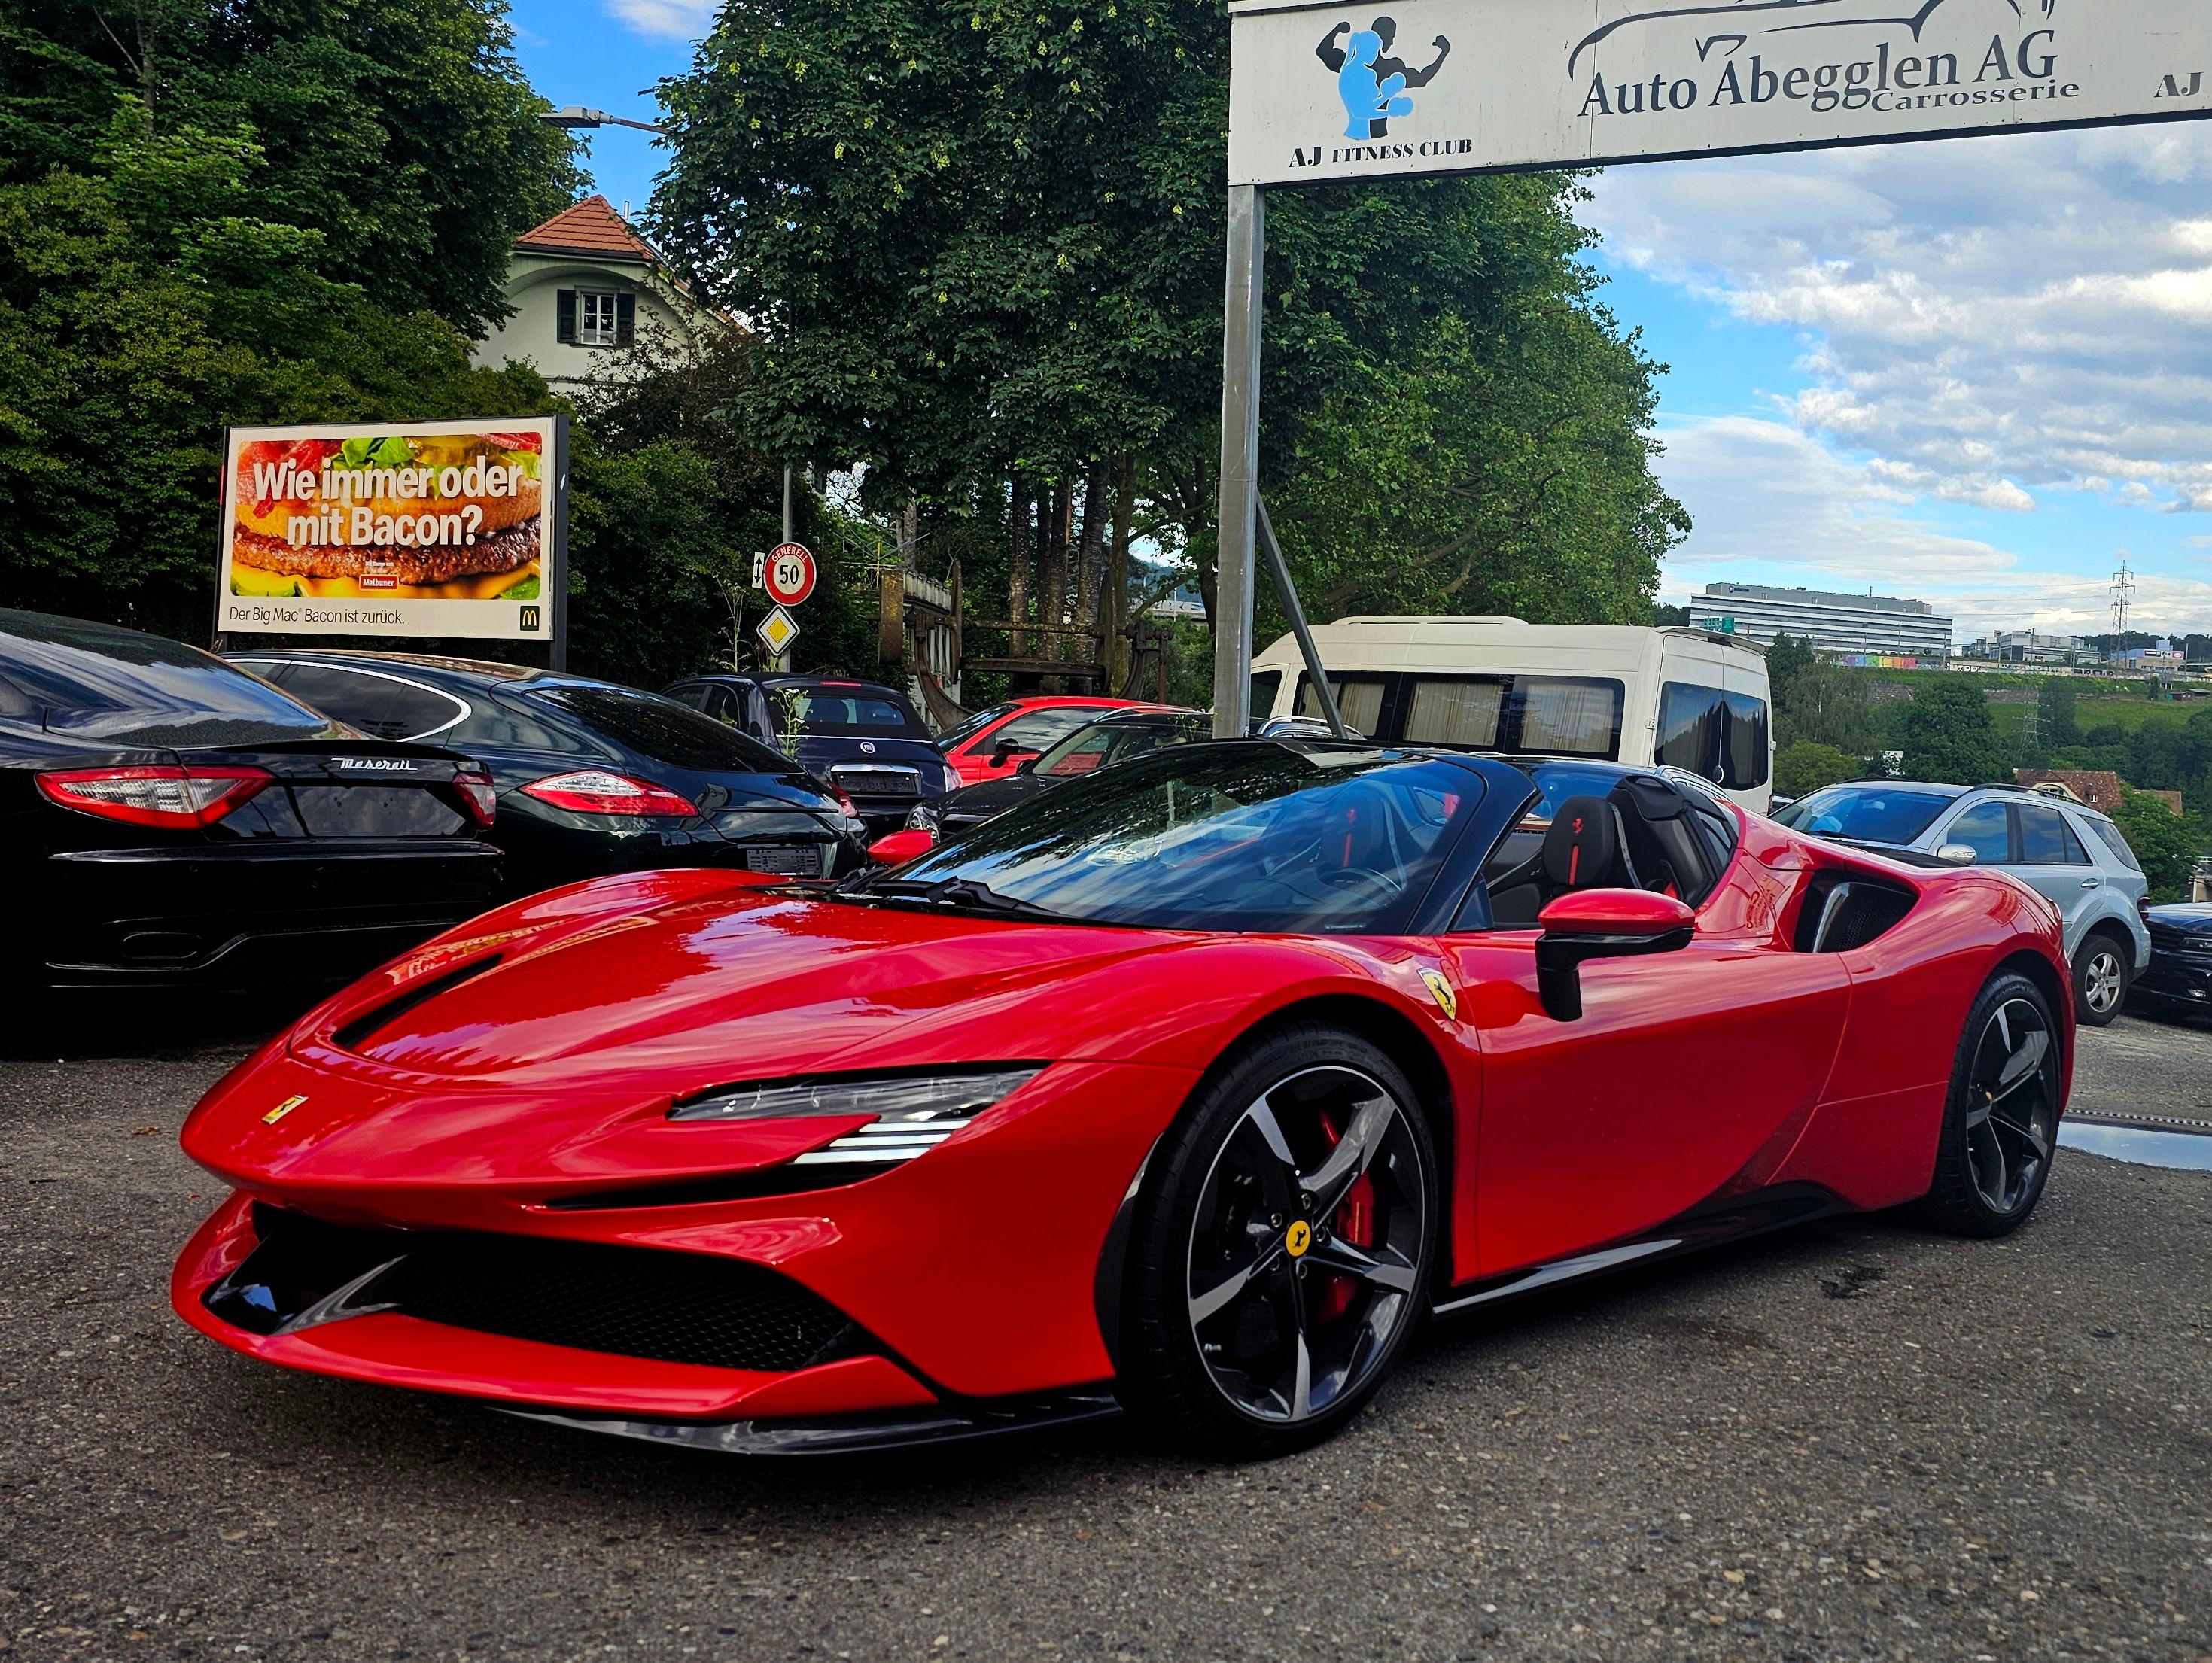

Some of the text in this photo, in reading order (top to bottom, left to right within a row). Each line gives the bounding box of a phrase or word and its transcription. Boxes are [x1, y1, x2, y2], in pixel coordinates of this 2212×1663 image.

[1577, 30, 2058, 117] Auto Abegglen AG
[2153, 72, 2204, 97] AJ
[1872, 79, 2079, 111] Carrosserie
[1289, 139, 1472, 168] AJ FITNESS CLUB
[253, 455, 523, 500] Wie immer oder
[287, 503, 483, 546] mit Bacon?
[771, 546, 808, 563] GENERELL
[780, 565, 799, 585] 50
[230, 607, 250, 621] Der
[253, 607, 270, 625] Big
[305, 609, 342, 623] Bacon
[345, 609, 359, 623] ist
[361, 610, 405, 624] zurück.
[331, 757, 418, 771] Maserati
